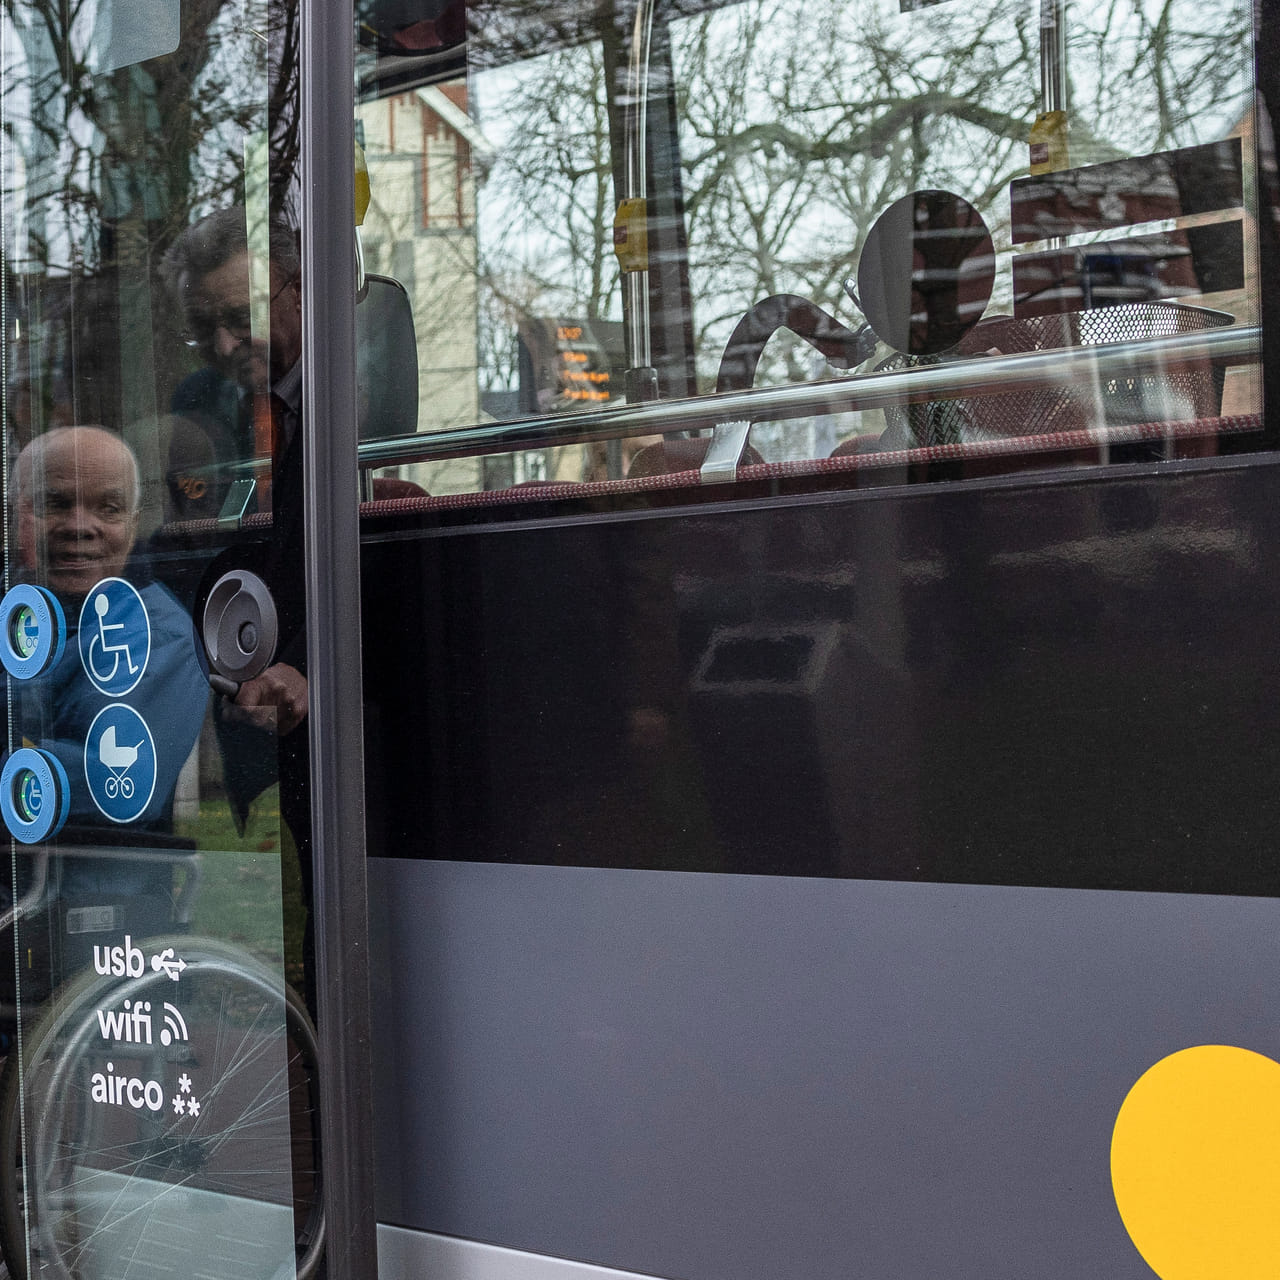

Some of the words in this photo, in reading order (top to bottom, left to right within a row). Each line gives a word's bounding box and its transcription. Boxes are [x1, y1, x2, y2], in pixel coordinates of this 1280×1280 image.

[93, 935, 144, 978] usb
[97, 1000, 152, 1044] wifi
[91, 1062, 163, 1111] airco
